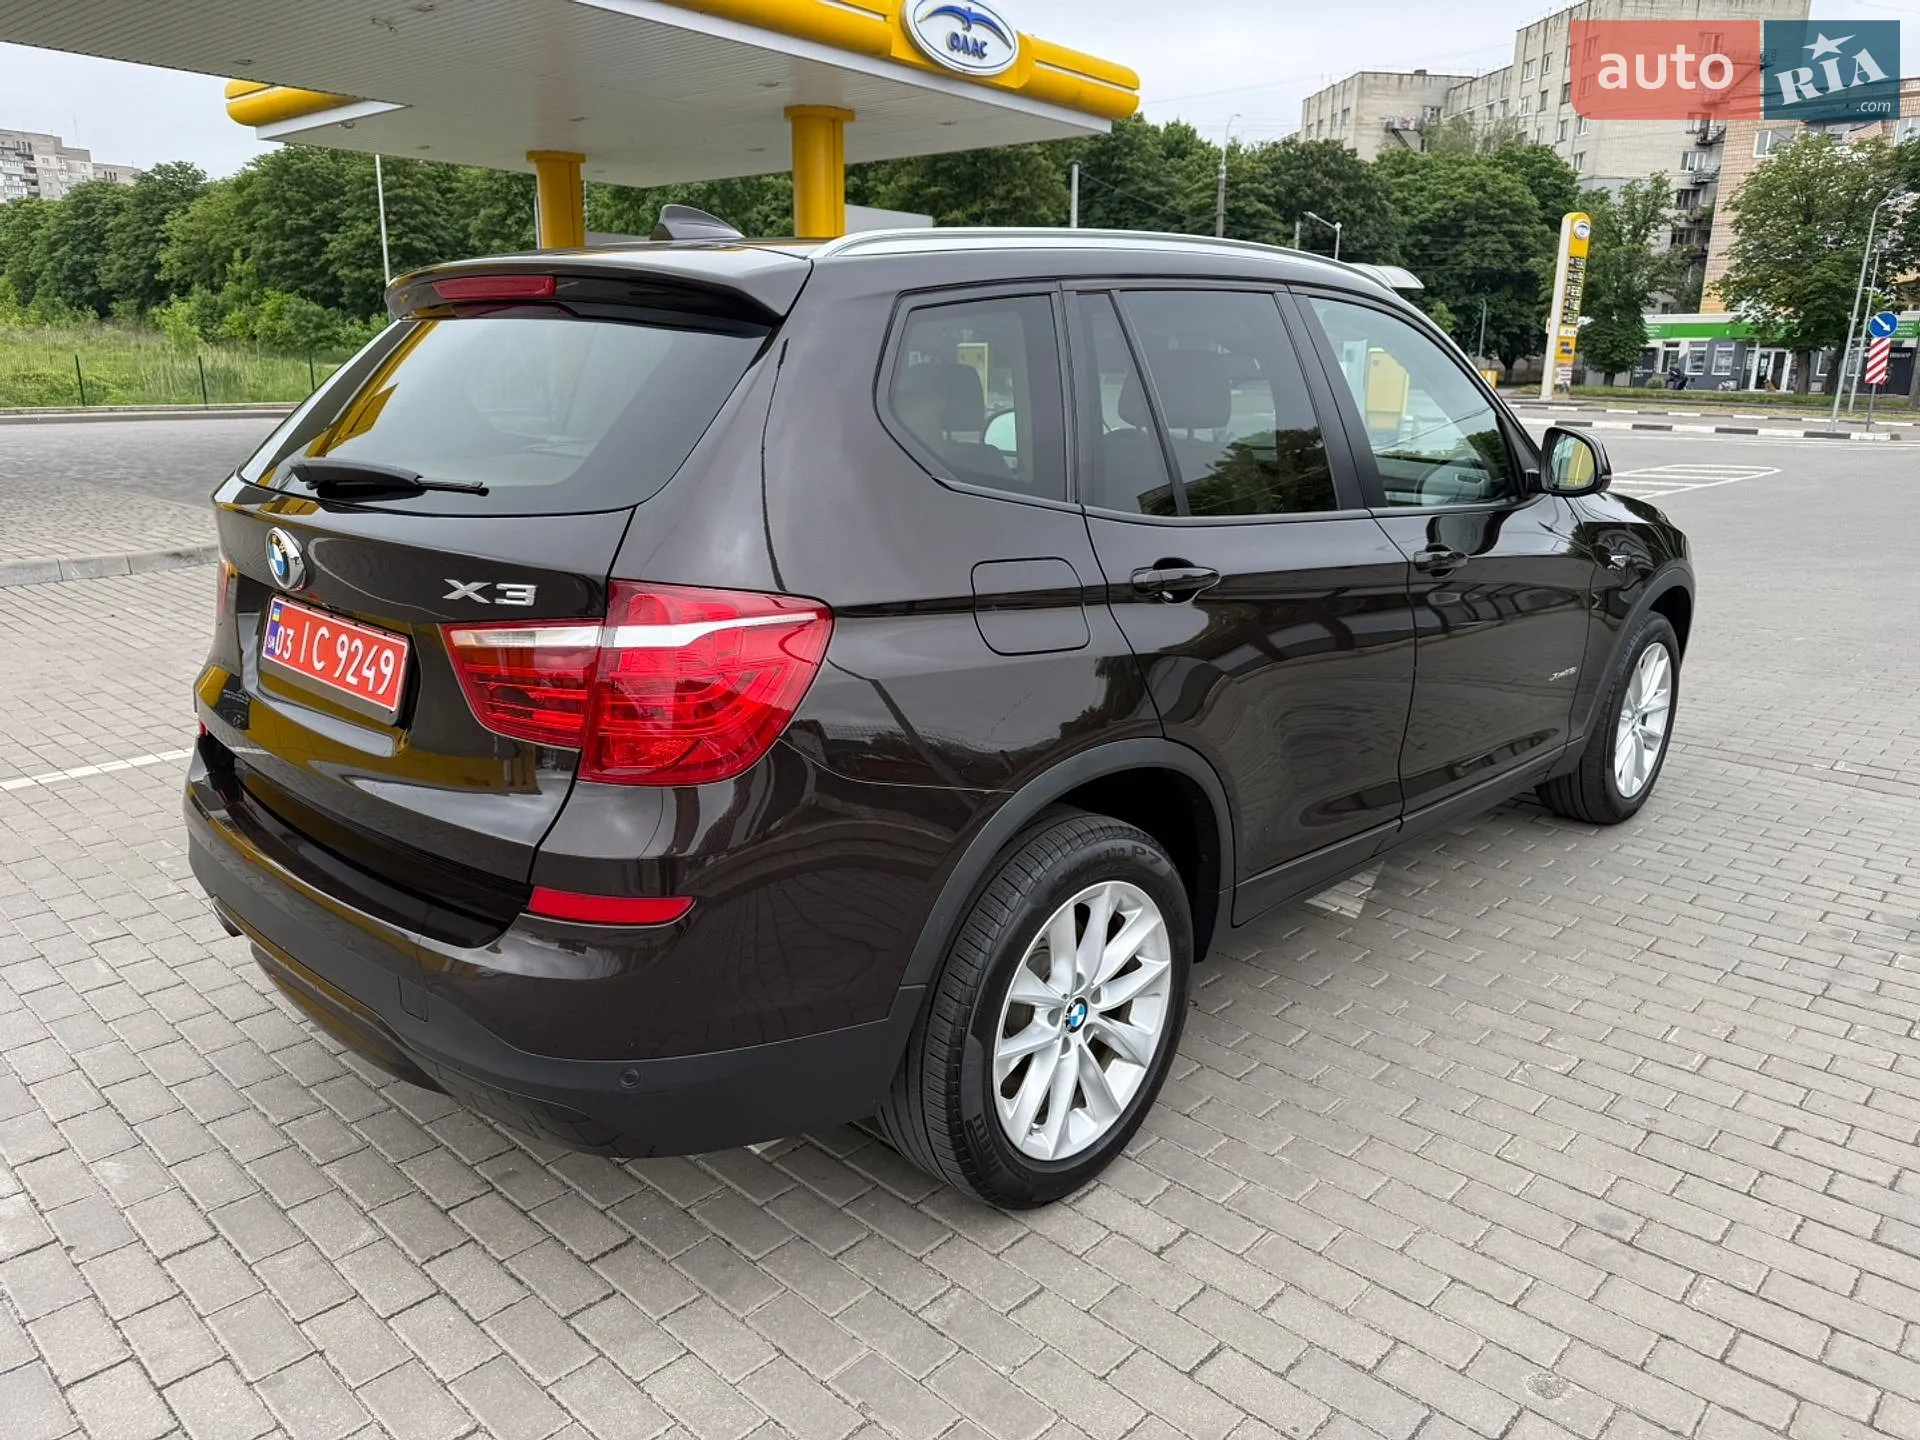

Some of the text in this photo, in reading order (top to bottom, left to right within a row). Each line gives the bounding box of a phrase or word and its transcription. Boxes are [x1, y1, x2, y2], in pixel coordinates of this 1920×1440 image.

[441, 578, 539, 607] X3
[274, 625, 295, 660] 03
[333, 633, 396, 695] 9249
